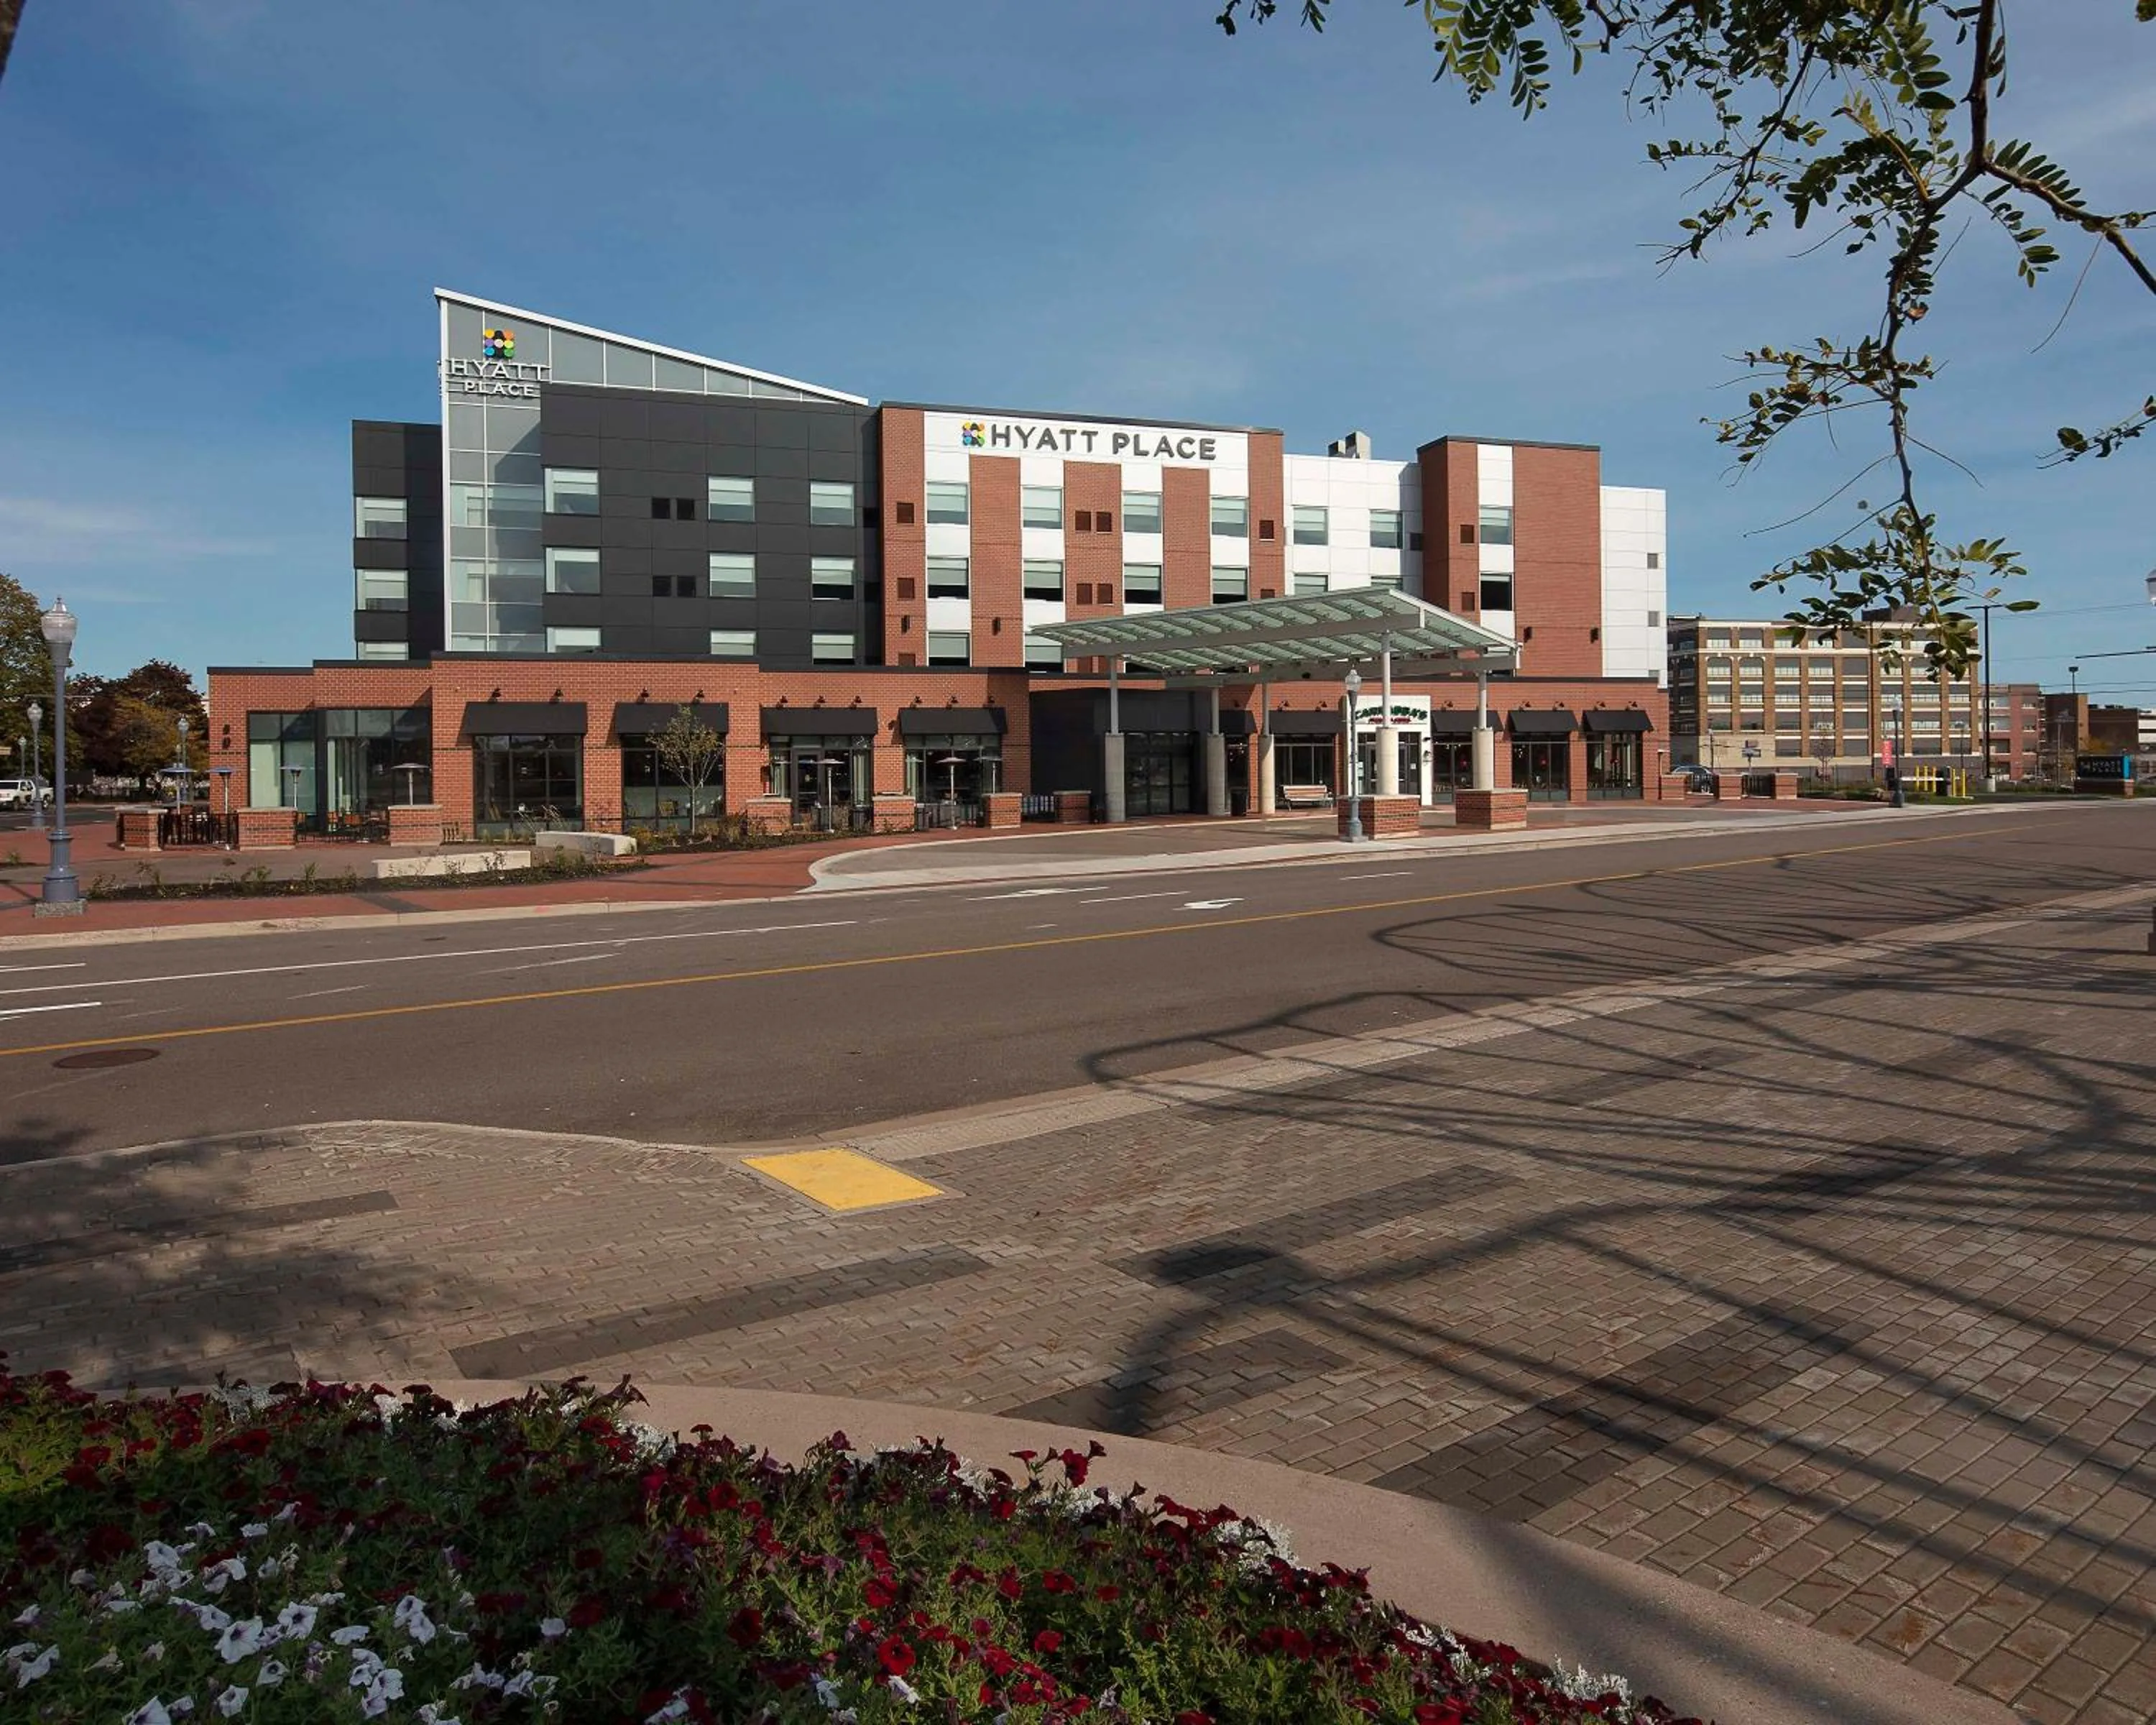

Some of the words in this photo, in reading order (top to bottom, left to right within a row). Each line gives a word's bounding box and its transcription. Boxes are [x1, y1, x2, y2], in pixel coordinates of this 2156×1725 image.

[451, 359, 550, 381] HYATT
[464, 381, 535, 396] PLACE
[991, 423, 1098, 453] HYATT
[1112, 432, 1216, 460] PLACE
